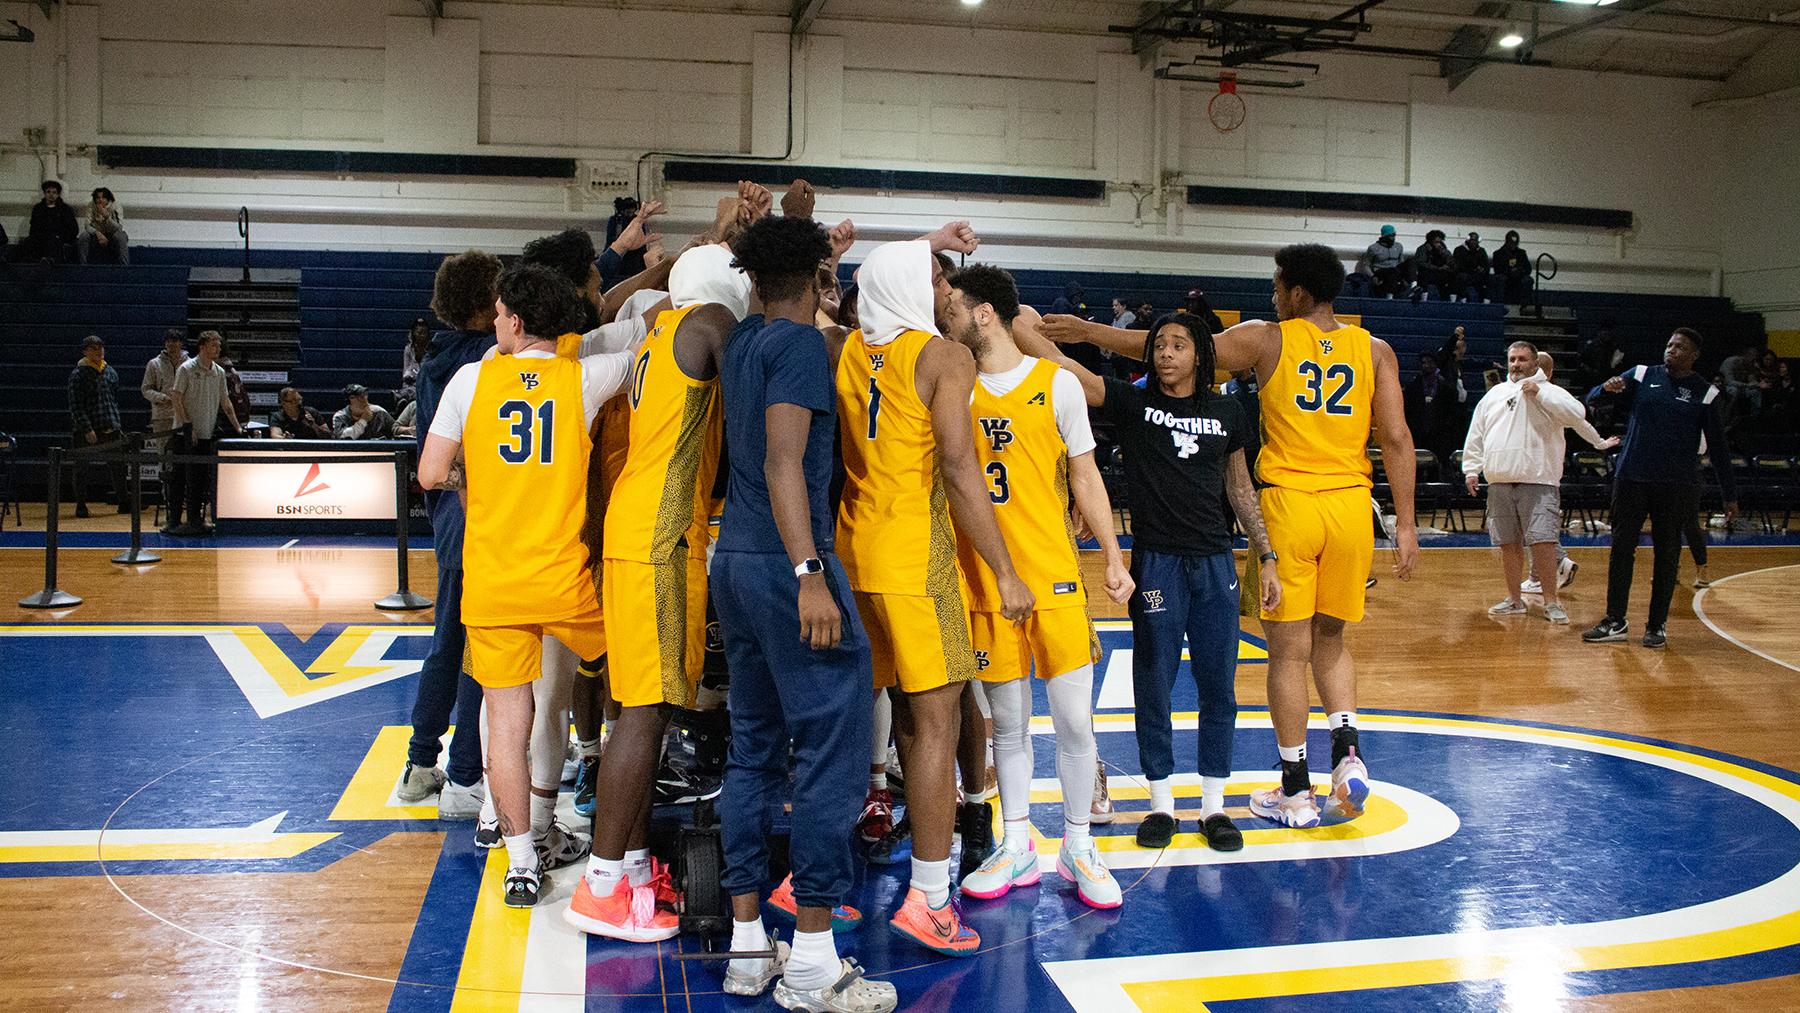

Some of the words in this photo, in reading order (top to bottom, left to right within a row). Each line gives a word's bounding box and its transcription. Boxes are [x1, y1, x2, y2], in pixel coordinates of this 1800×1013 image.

[869, 353, 884, 371] WP
[1319, 340, 1334, 355] WP
[519, 371, 539, 391] WP
[631, 347, 651, 413] 0
[1295, 359, 1354, 416] 32
[867, 376, 882, 441] 1
[1144, 406, 1228, 437] TOGETHER.
[498, 399, 555, 465] 31
[979, 417, 1014, 453] WP
[1171, 430, 1200, 459] WP
[986, 461, 1010, 505] 3
[276, 505, 302, 515] BSN
[303, 505, 343, 515] SPORTS
[1142, 590, 1164, 609] WP
